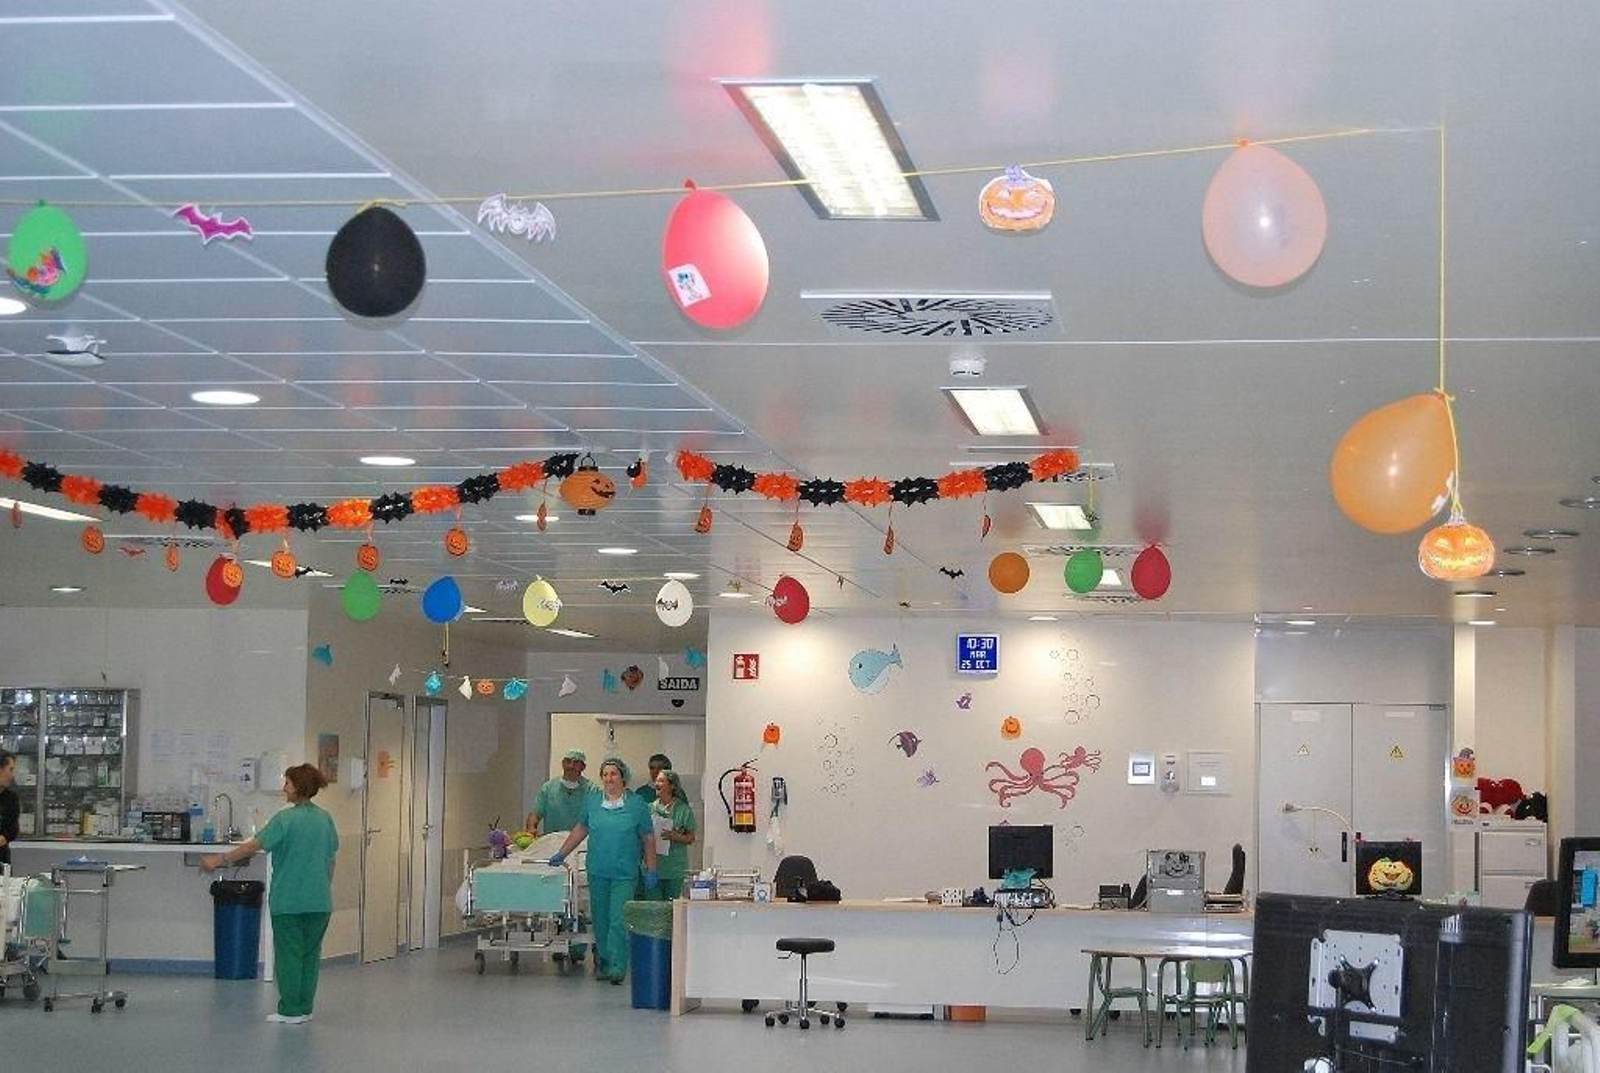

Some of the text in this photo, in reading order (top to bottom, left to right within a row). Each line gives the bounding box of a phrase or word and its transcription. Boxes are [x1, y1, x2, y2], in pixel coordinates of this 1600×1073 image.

[966, 638, 994, 649] 10:30
[970, 650, 986, 659] MAR
[961, 660, 990, 669] 25 OCT
